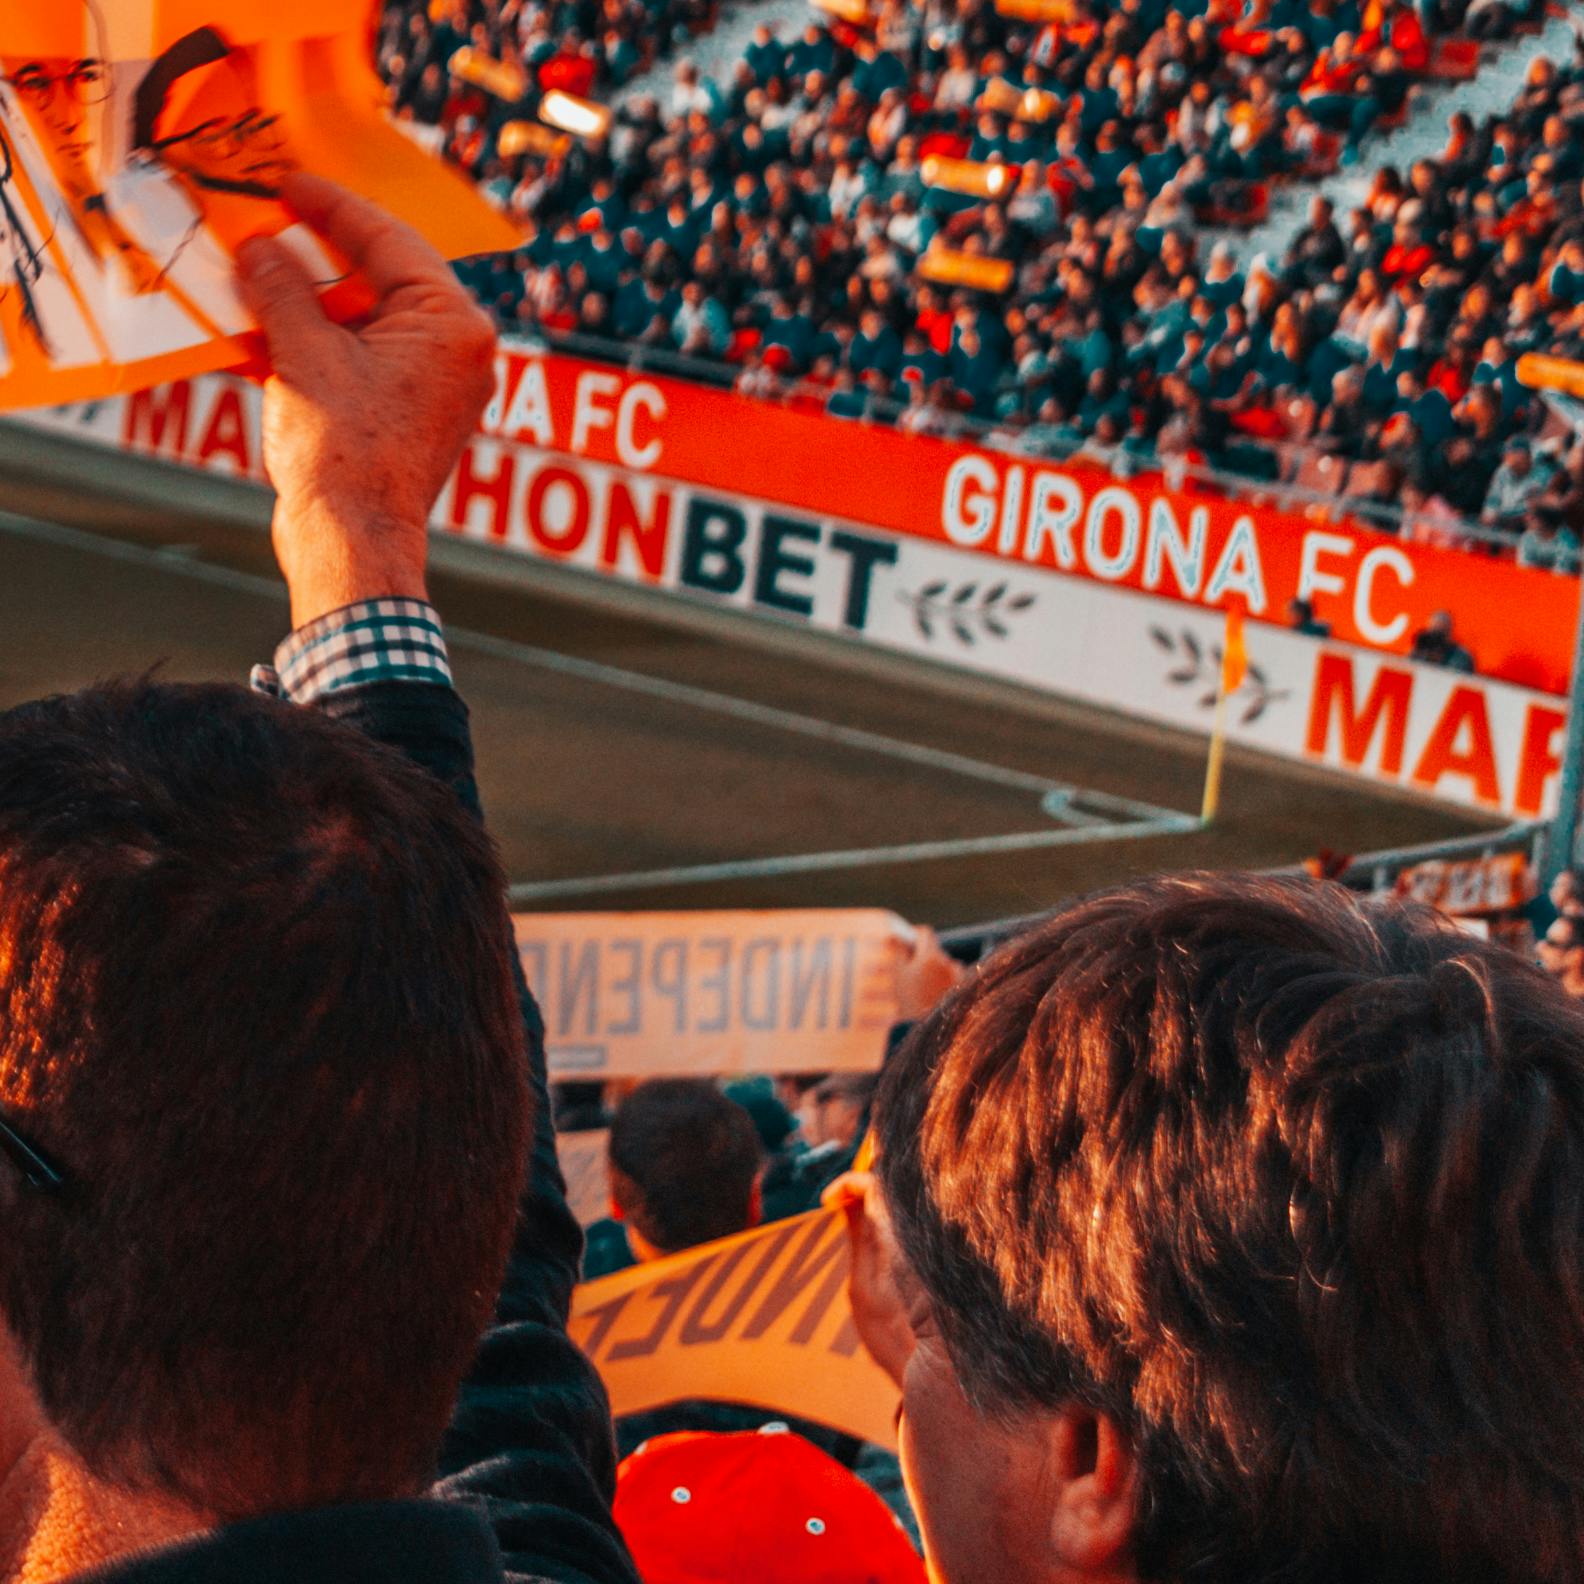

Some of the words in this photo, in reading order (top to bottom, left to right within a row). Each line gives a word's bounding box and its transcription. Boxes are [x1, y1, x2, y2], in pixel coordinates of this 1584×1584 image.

[569, 369, 669, 467] FC
[940, 454, 1268, 616] GIRONA
[1298, 531, 1415, 643] FC
